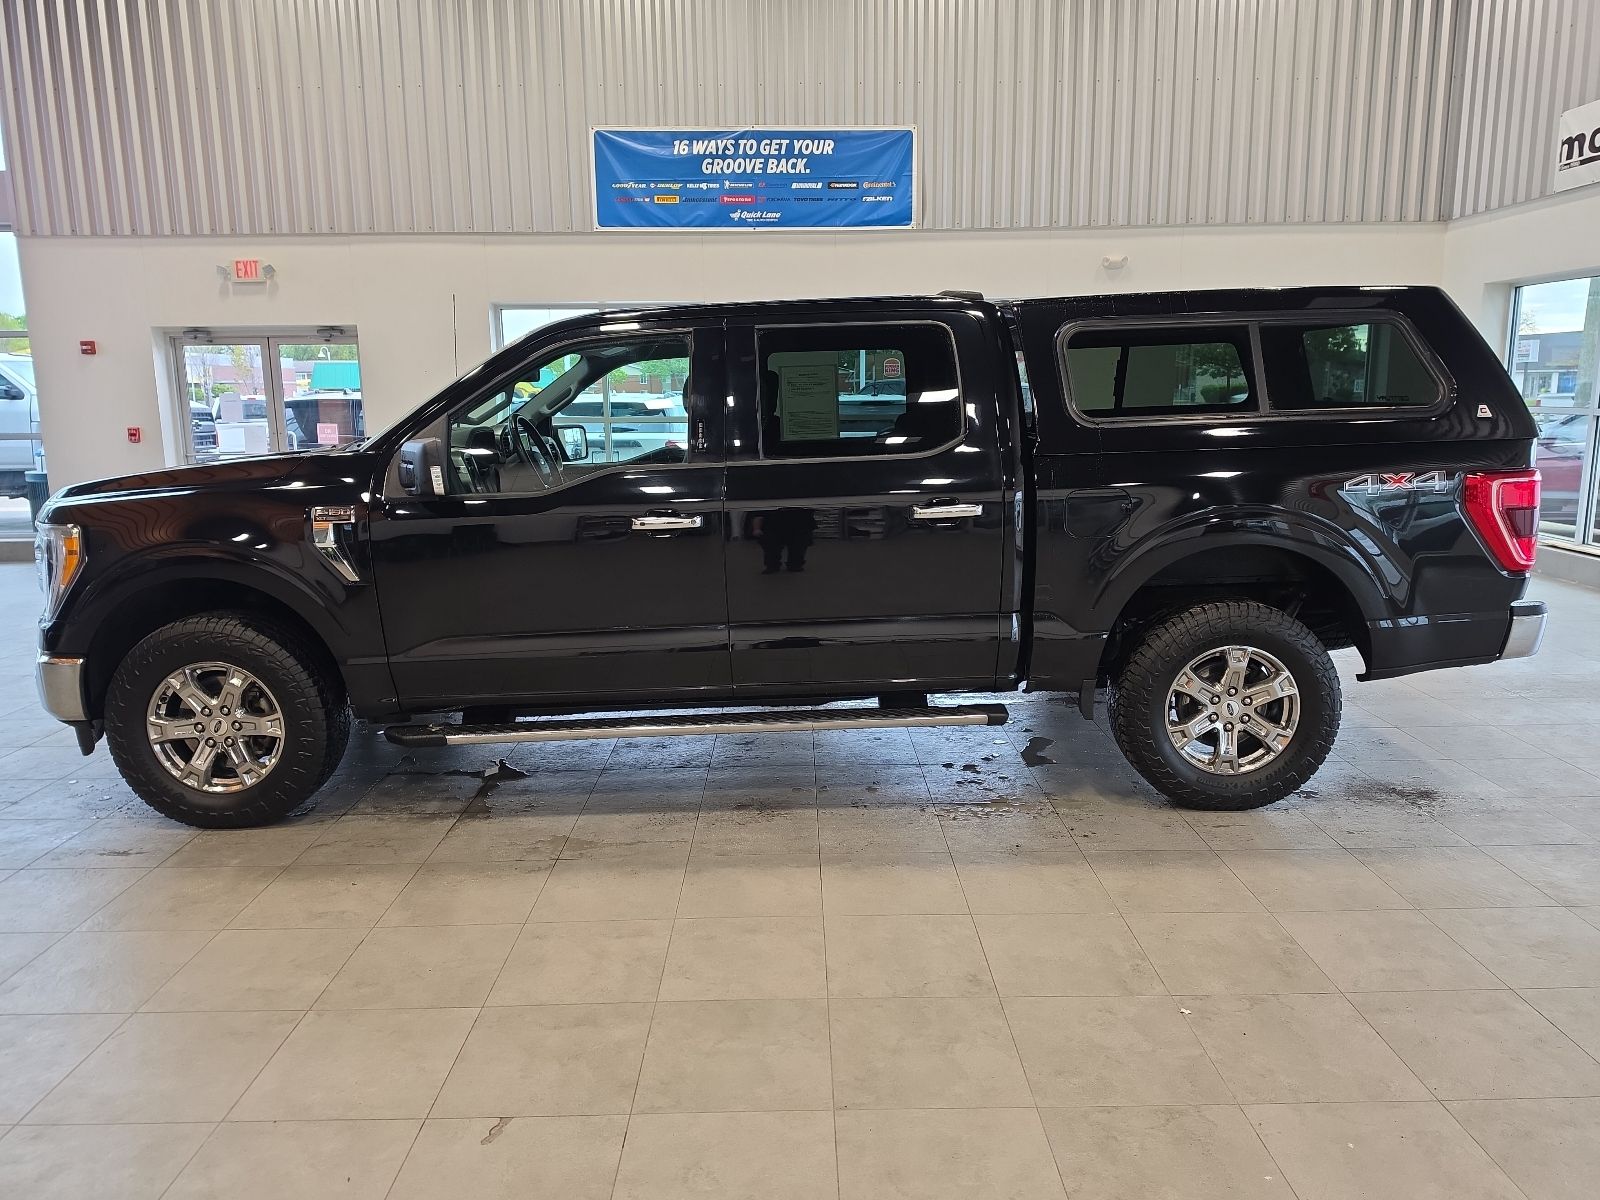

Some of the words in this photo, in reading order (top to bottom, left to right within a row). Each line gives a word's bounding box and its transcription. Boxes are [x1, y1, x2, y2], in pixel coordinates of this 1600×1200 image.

[673, 140, 689, 155] 16
[692, 139, 735, 155] WAYS
[738, 139, 757, 155] TO
[760, 139, 789, 155] GET
[794, 139, 835, 155] YOUR
[702, 158, 764, 174] GROOVE
[766, 158, 811, 174] BACK.
[741, 211, 762, 219] Quick
[235, 260, 259, 279] EXIT
[315, 509, 350, 517] F-150
